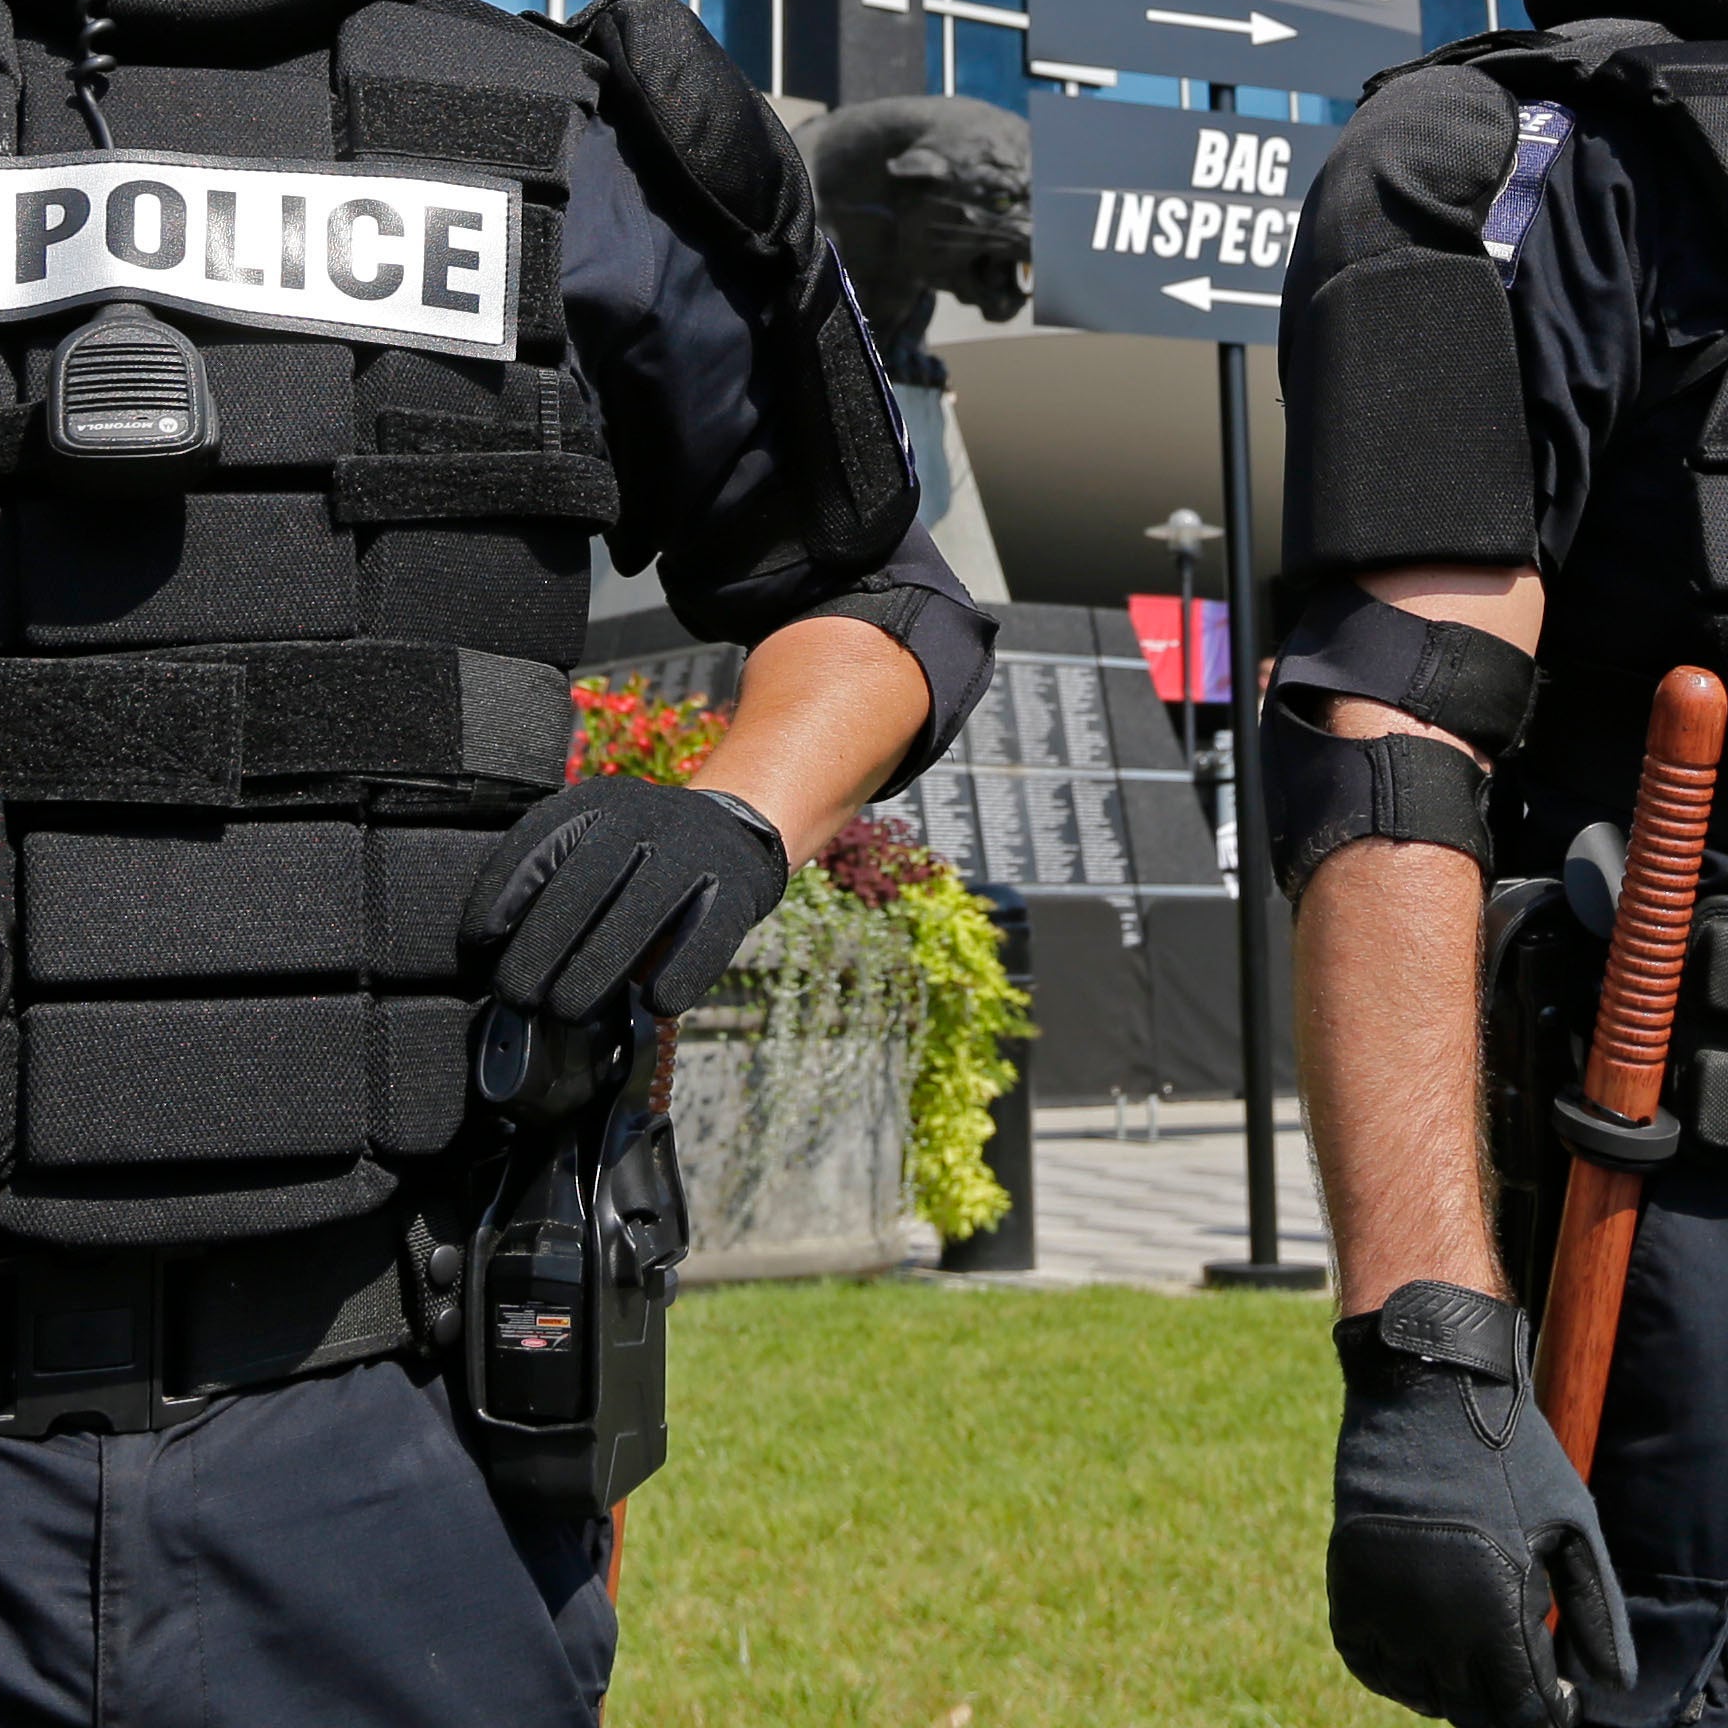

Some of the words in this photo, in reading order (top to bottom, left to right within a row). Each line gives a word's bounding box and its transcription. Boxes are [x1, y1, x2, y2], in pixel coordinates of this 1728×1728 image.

[1190, 127, 1292, 198] BAG
[14, 179, 485, 315] POLICE
[76, 421, 154, 432] MOTOROLA
